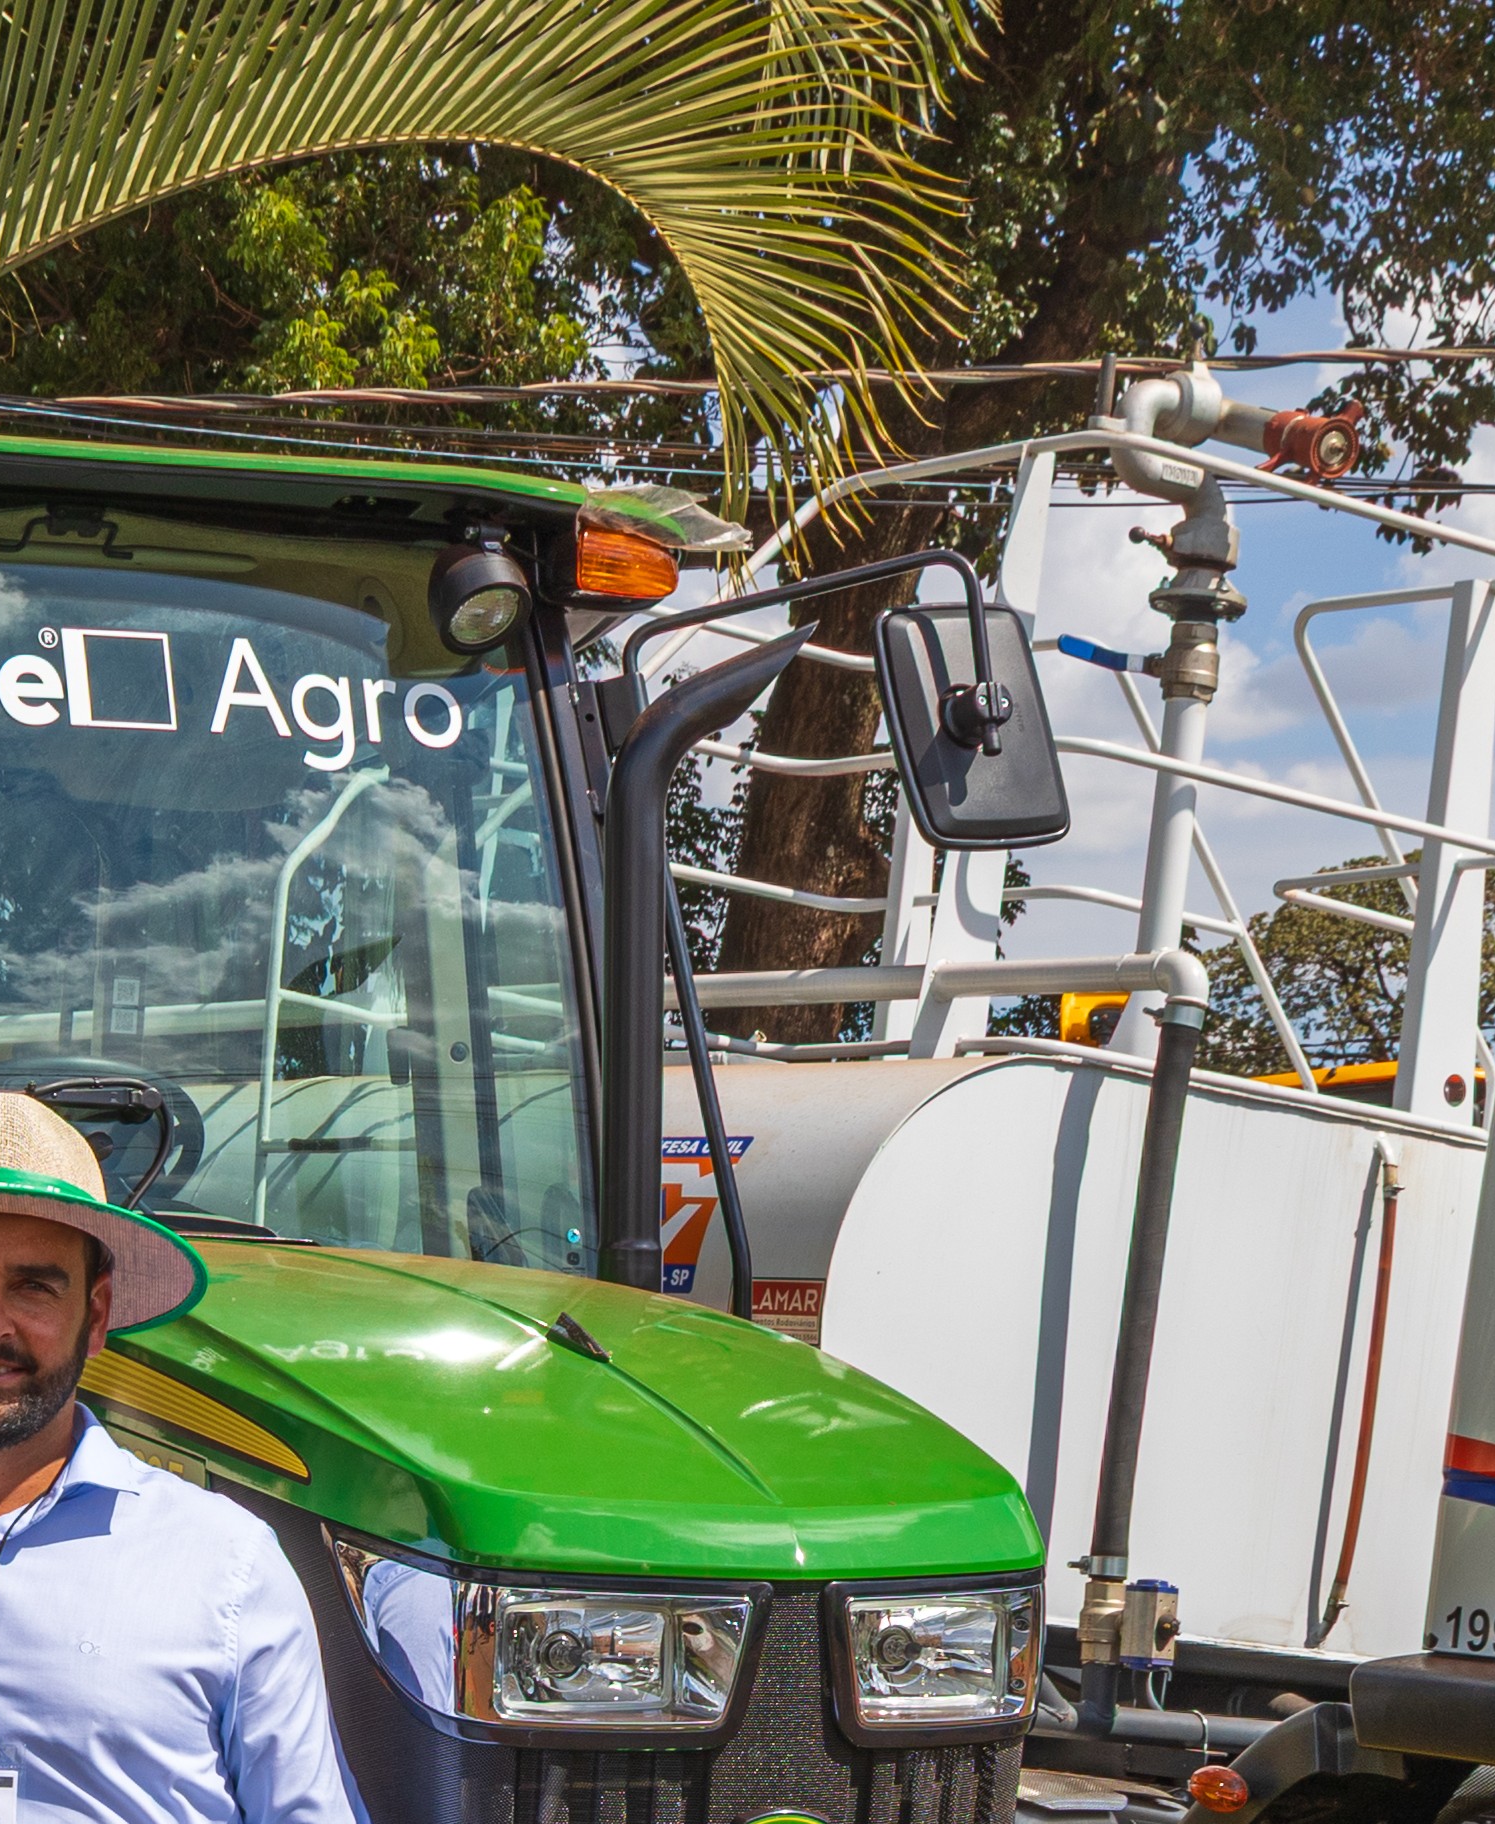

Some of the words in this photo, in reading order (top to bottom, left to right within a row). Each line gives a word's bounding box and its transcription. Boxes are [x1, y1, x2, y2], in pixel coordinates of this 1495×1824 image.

[210, 637, 464, 772] Agro
[662, 1141, 701, 1154] FESA
[670, 1268, 690, 1286] SP
